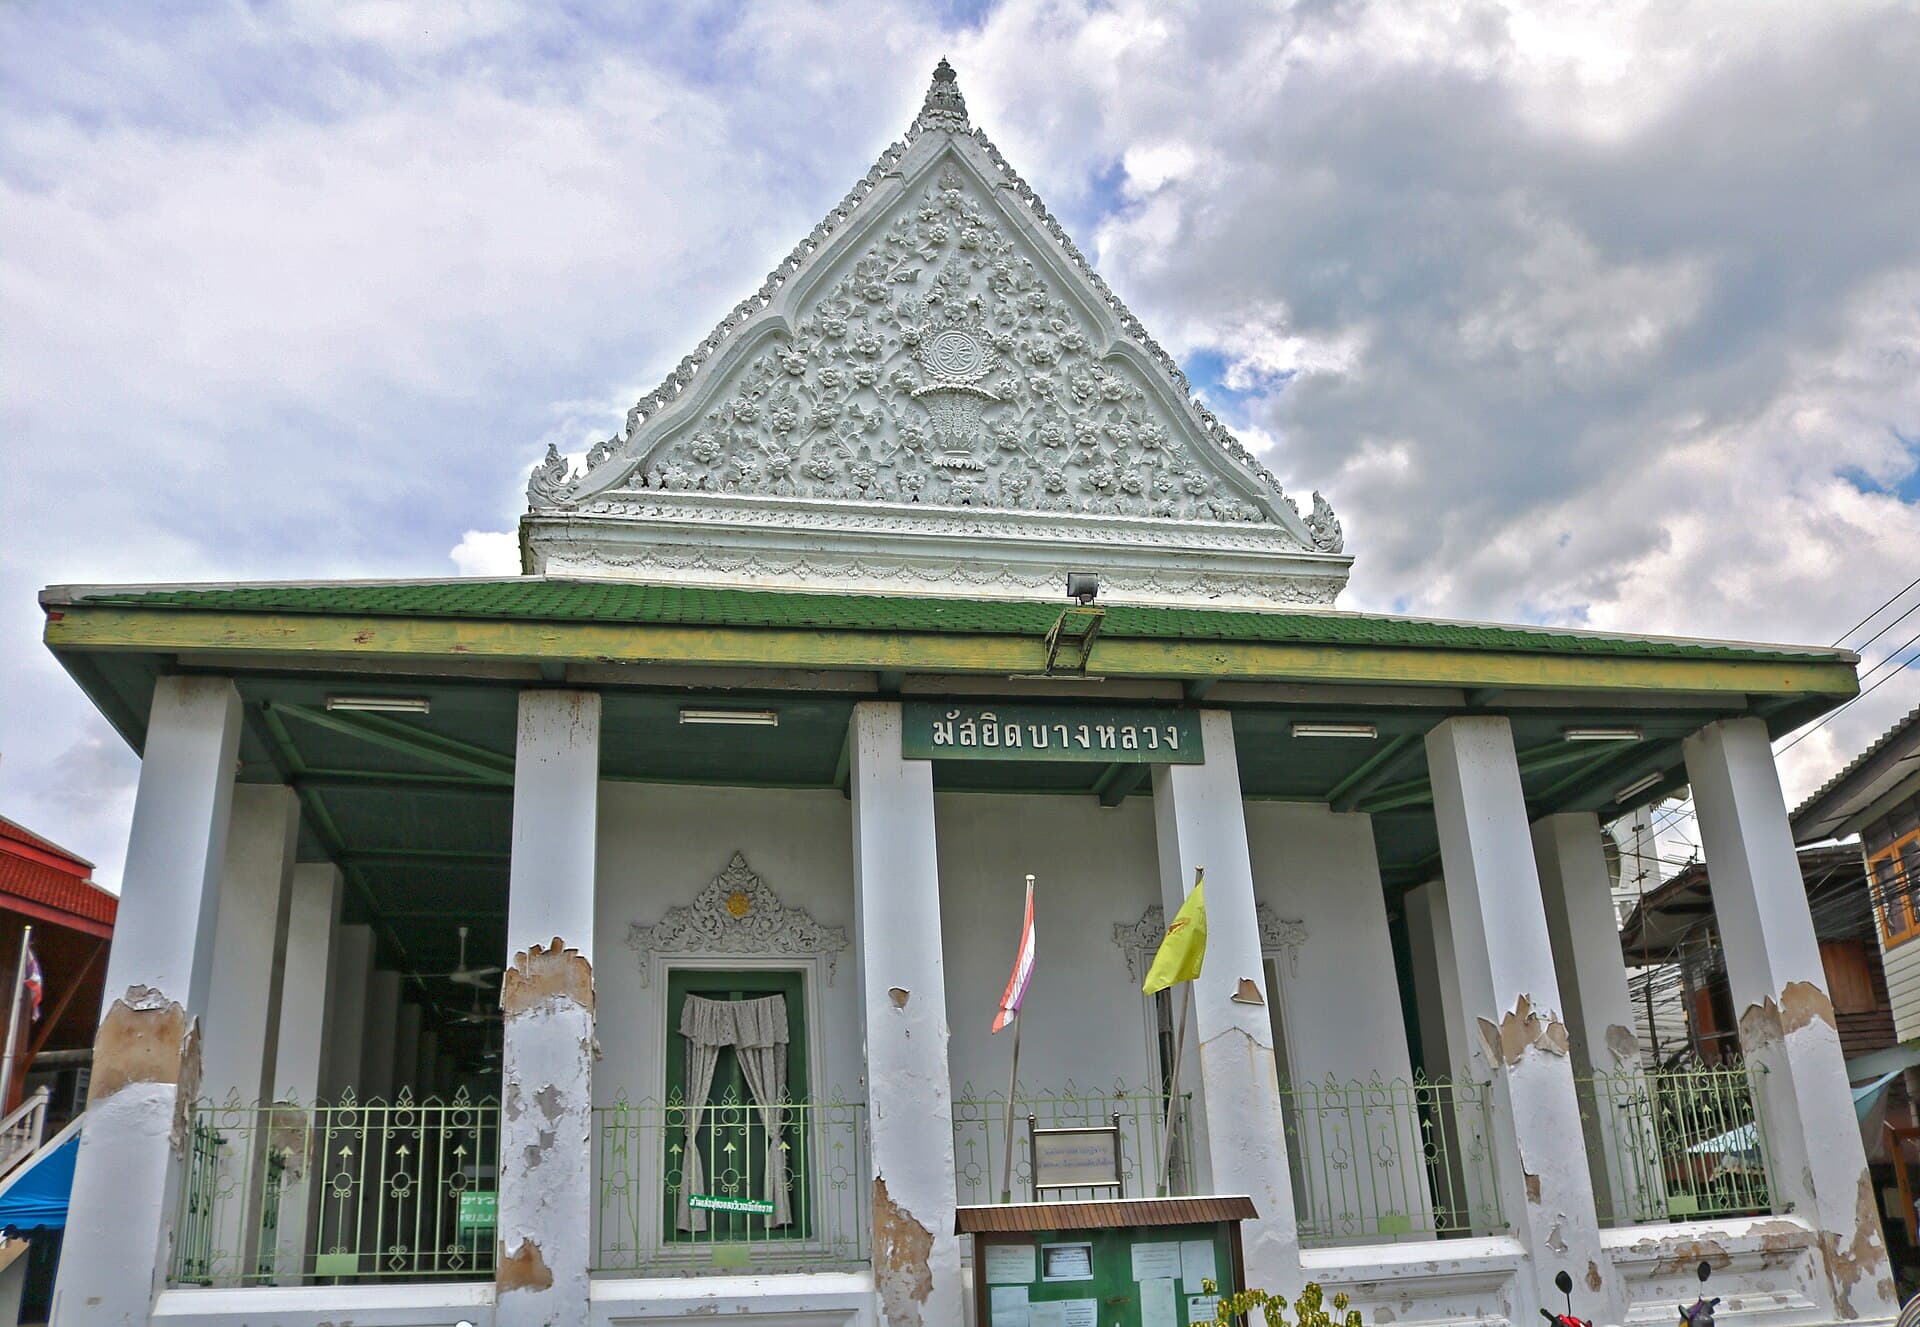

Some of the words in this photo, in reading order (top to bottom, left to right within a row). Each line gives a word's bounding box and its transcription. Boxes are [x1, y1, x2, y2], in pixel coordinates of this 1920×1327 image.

[932, 709, 1179, 750] มัสยิดบางหลวง
